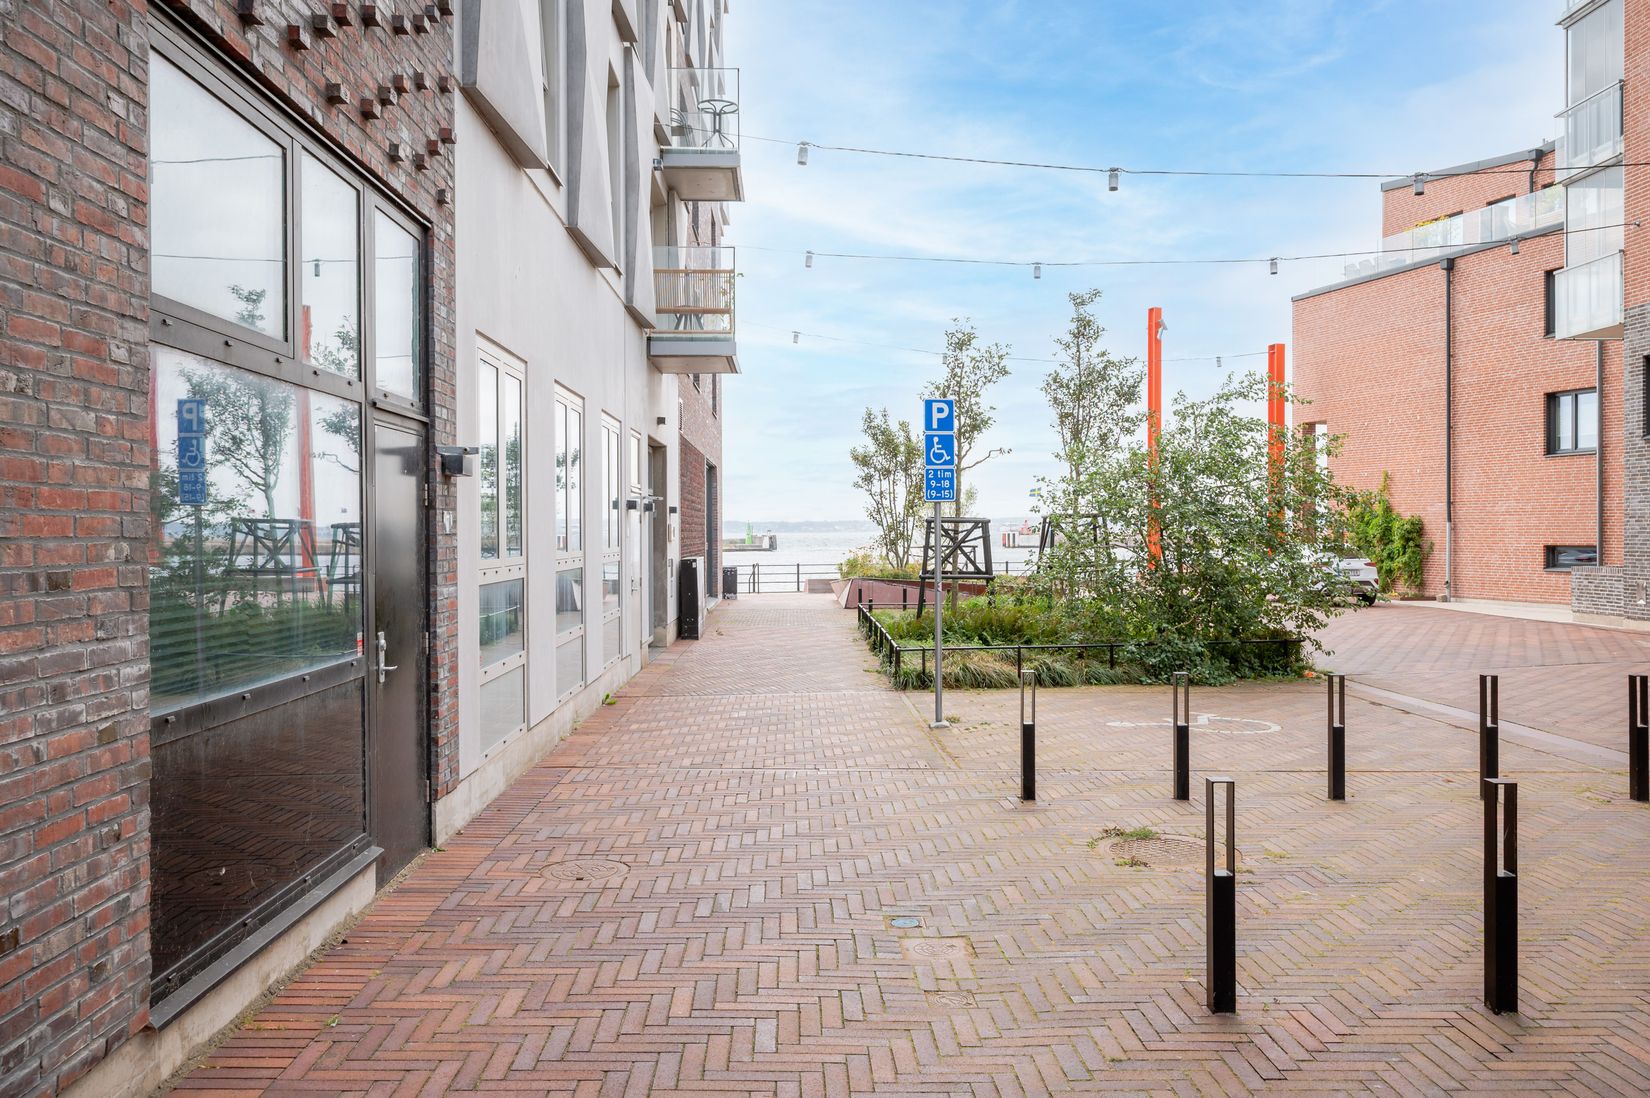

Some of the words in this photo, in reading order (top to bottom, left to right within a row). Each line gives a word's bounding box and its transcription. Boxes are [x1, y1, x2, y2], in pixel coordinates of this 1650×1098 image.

[932, 402, 949, 429] P
[928, 470, 934, 478] 2
[937, 470, 952, 478] tim
[930, 480, 950, 488] 9-18
[927, 489, 953, 499] (9-15)
